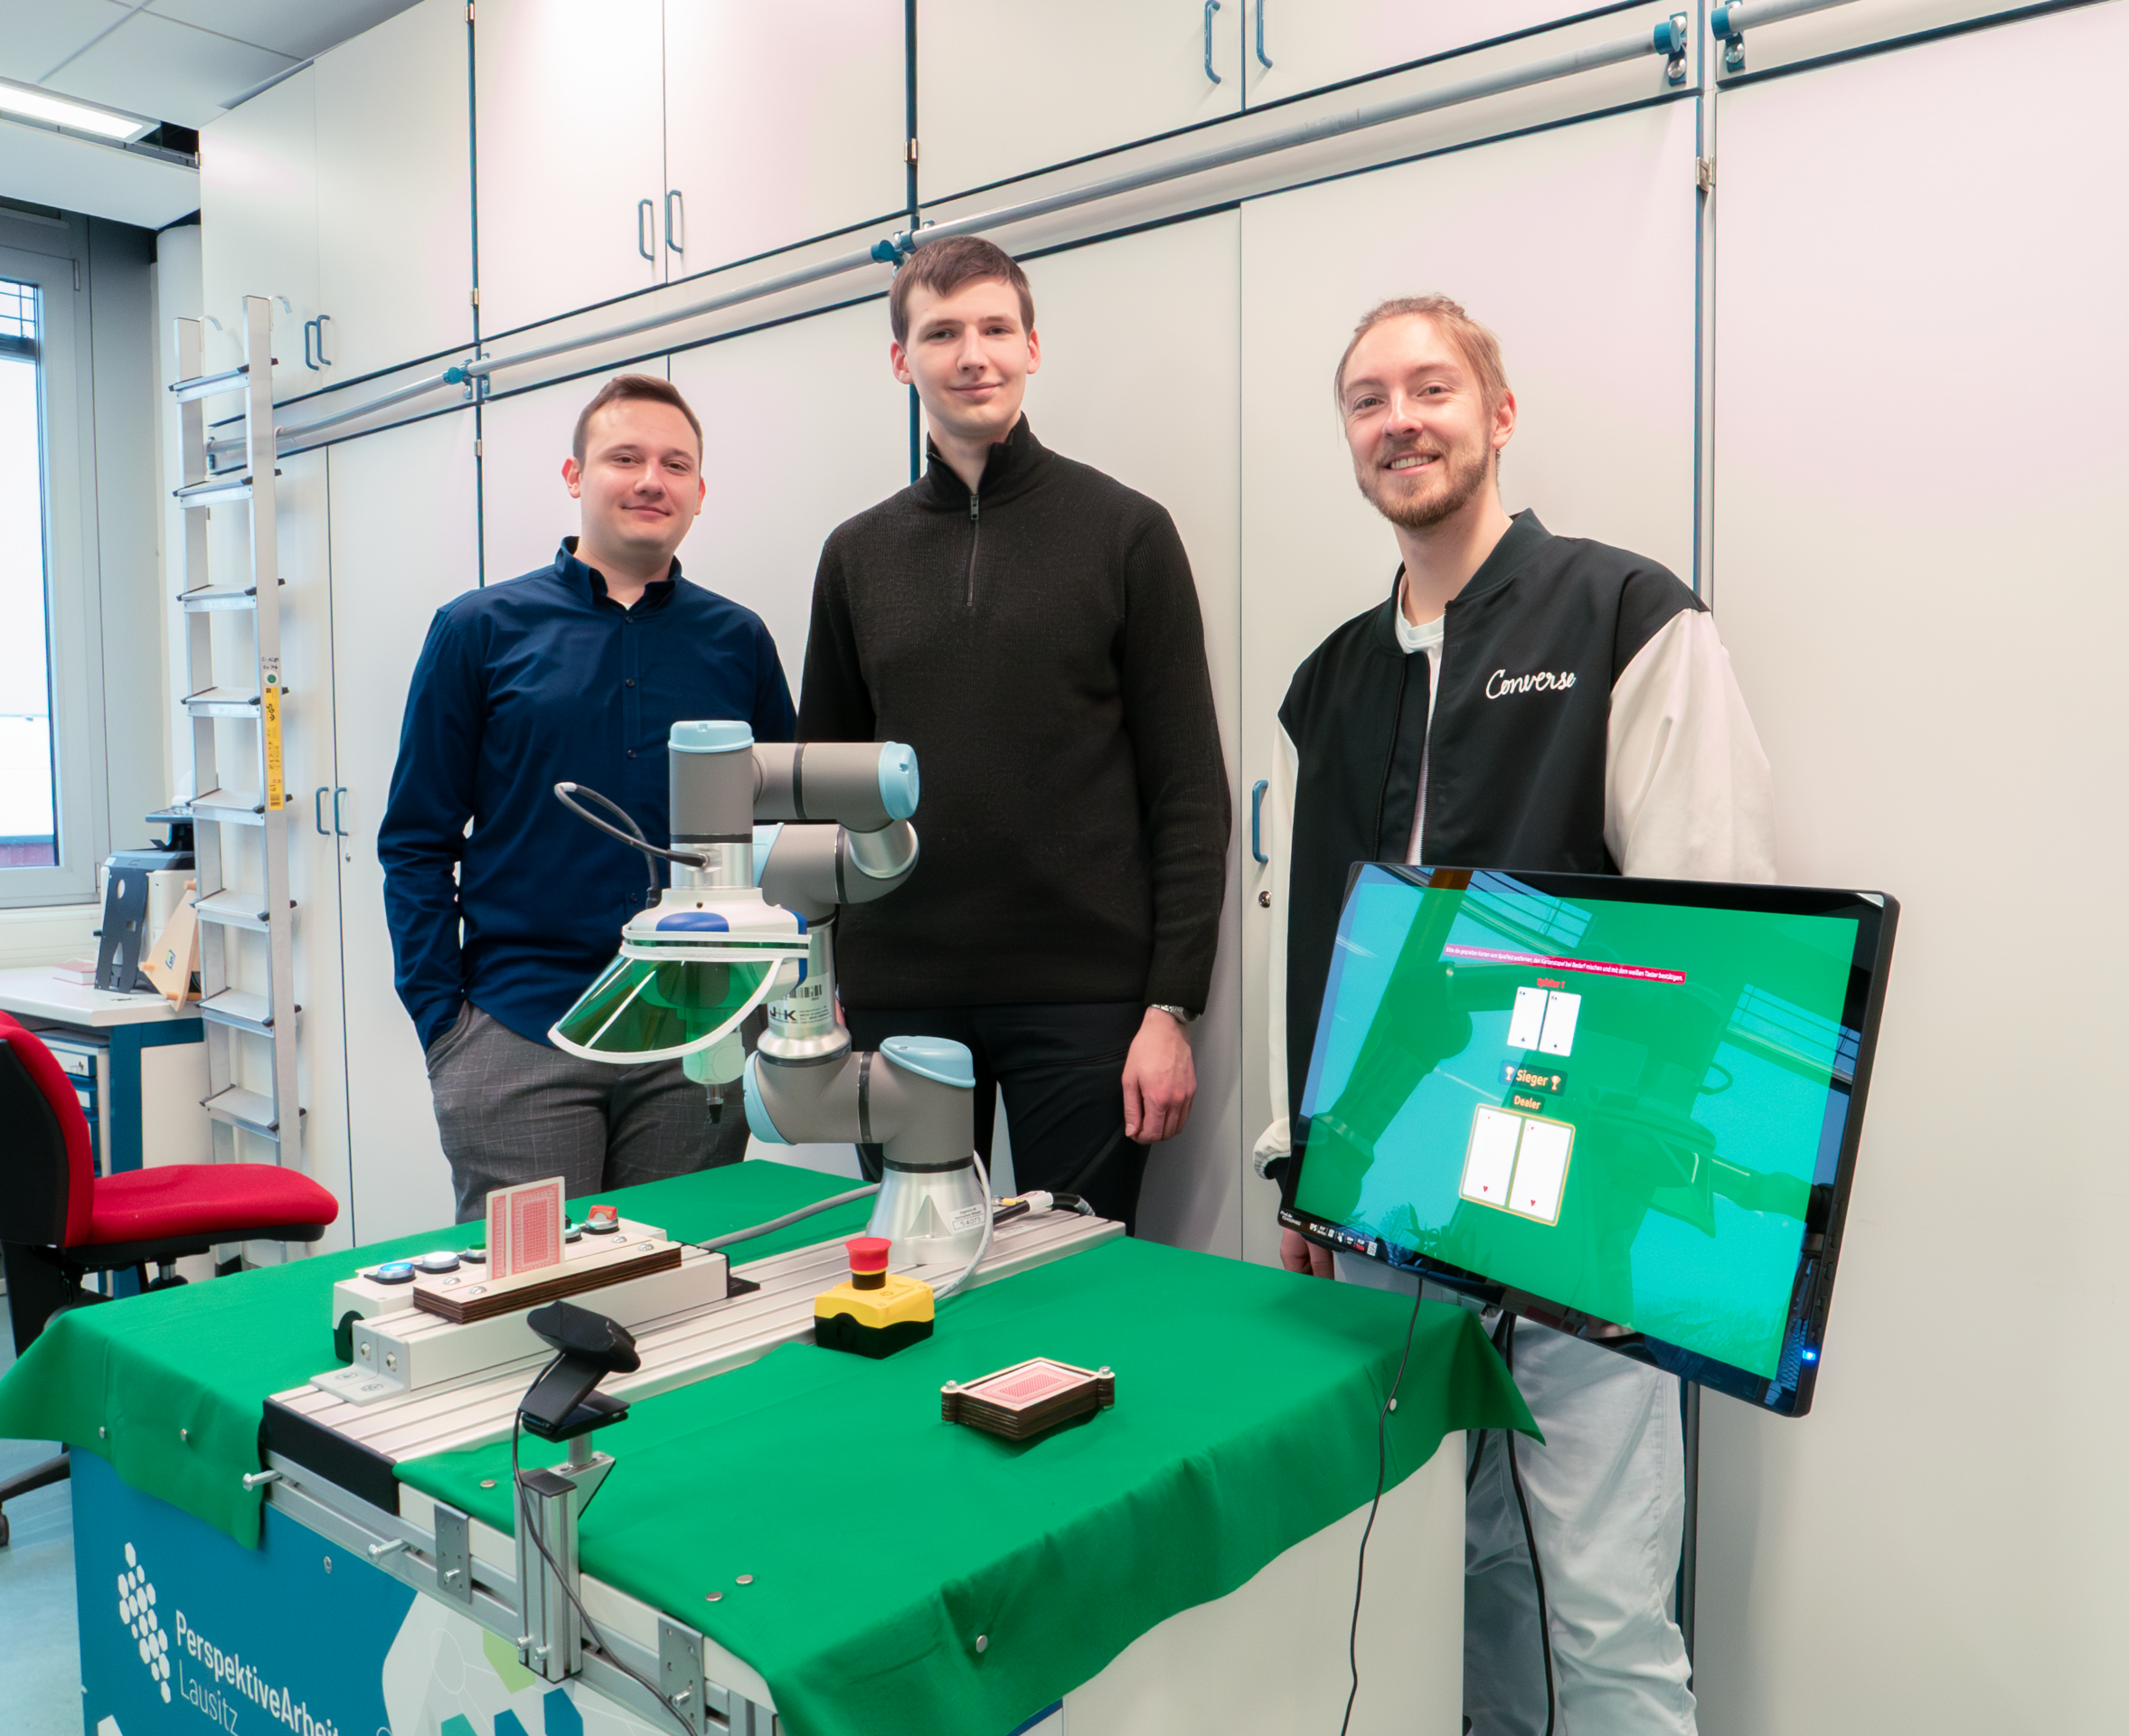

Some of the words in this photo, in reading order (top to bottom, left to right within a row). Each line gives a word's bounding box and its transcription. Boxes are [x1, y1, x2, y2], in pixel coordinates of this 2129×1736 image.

[1485, 668, 1577, 699] Converse
[1516, 1069, 1548, 1086] Sieger
[1514, 1095, 1541, 1110] Dealer
[179, 1659, 239, 1736] Lausitz
